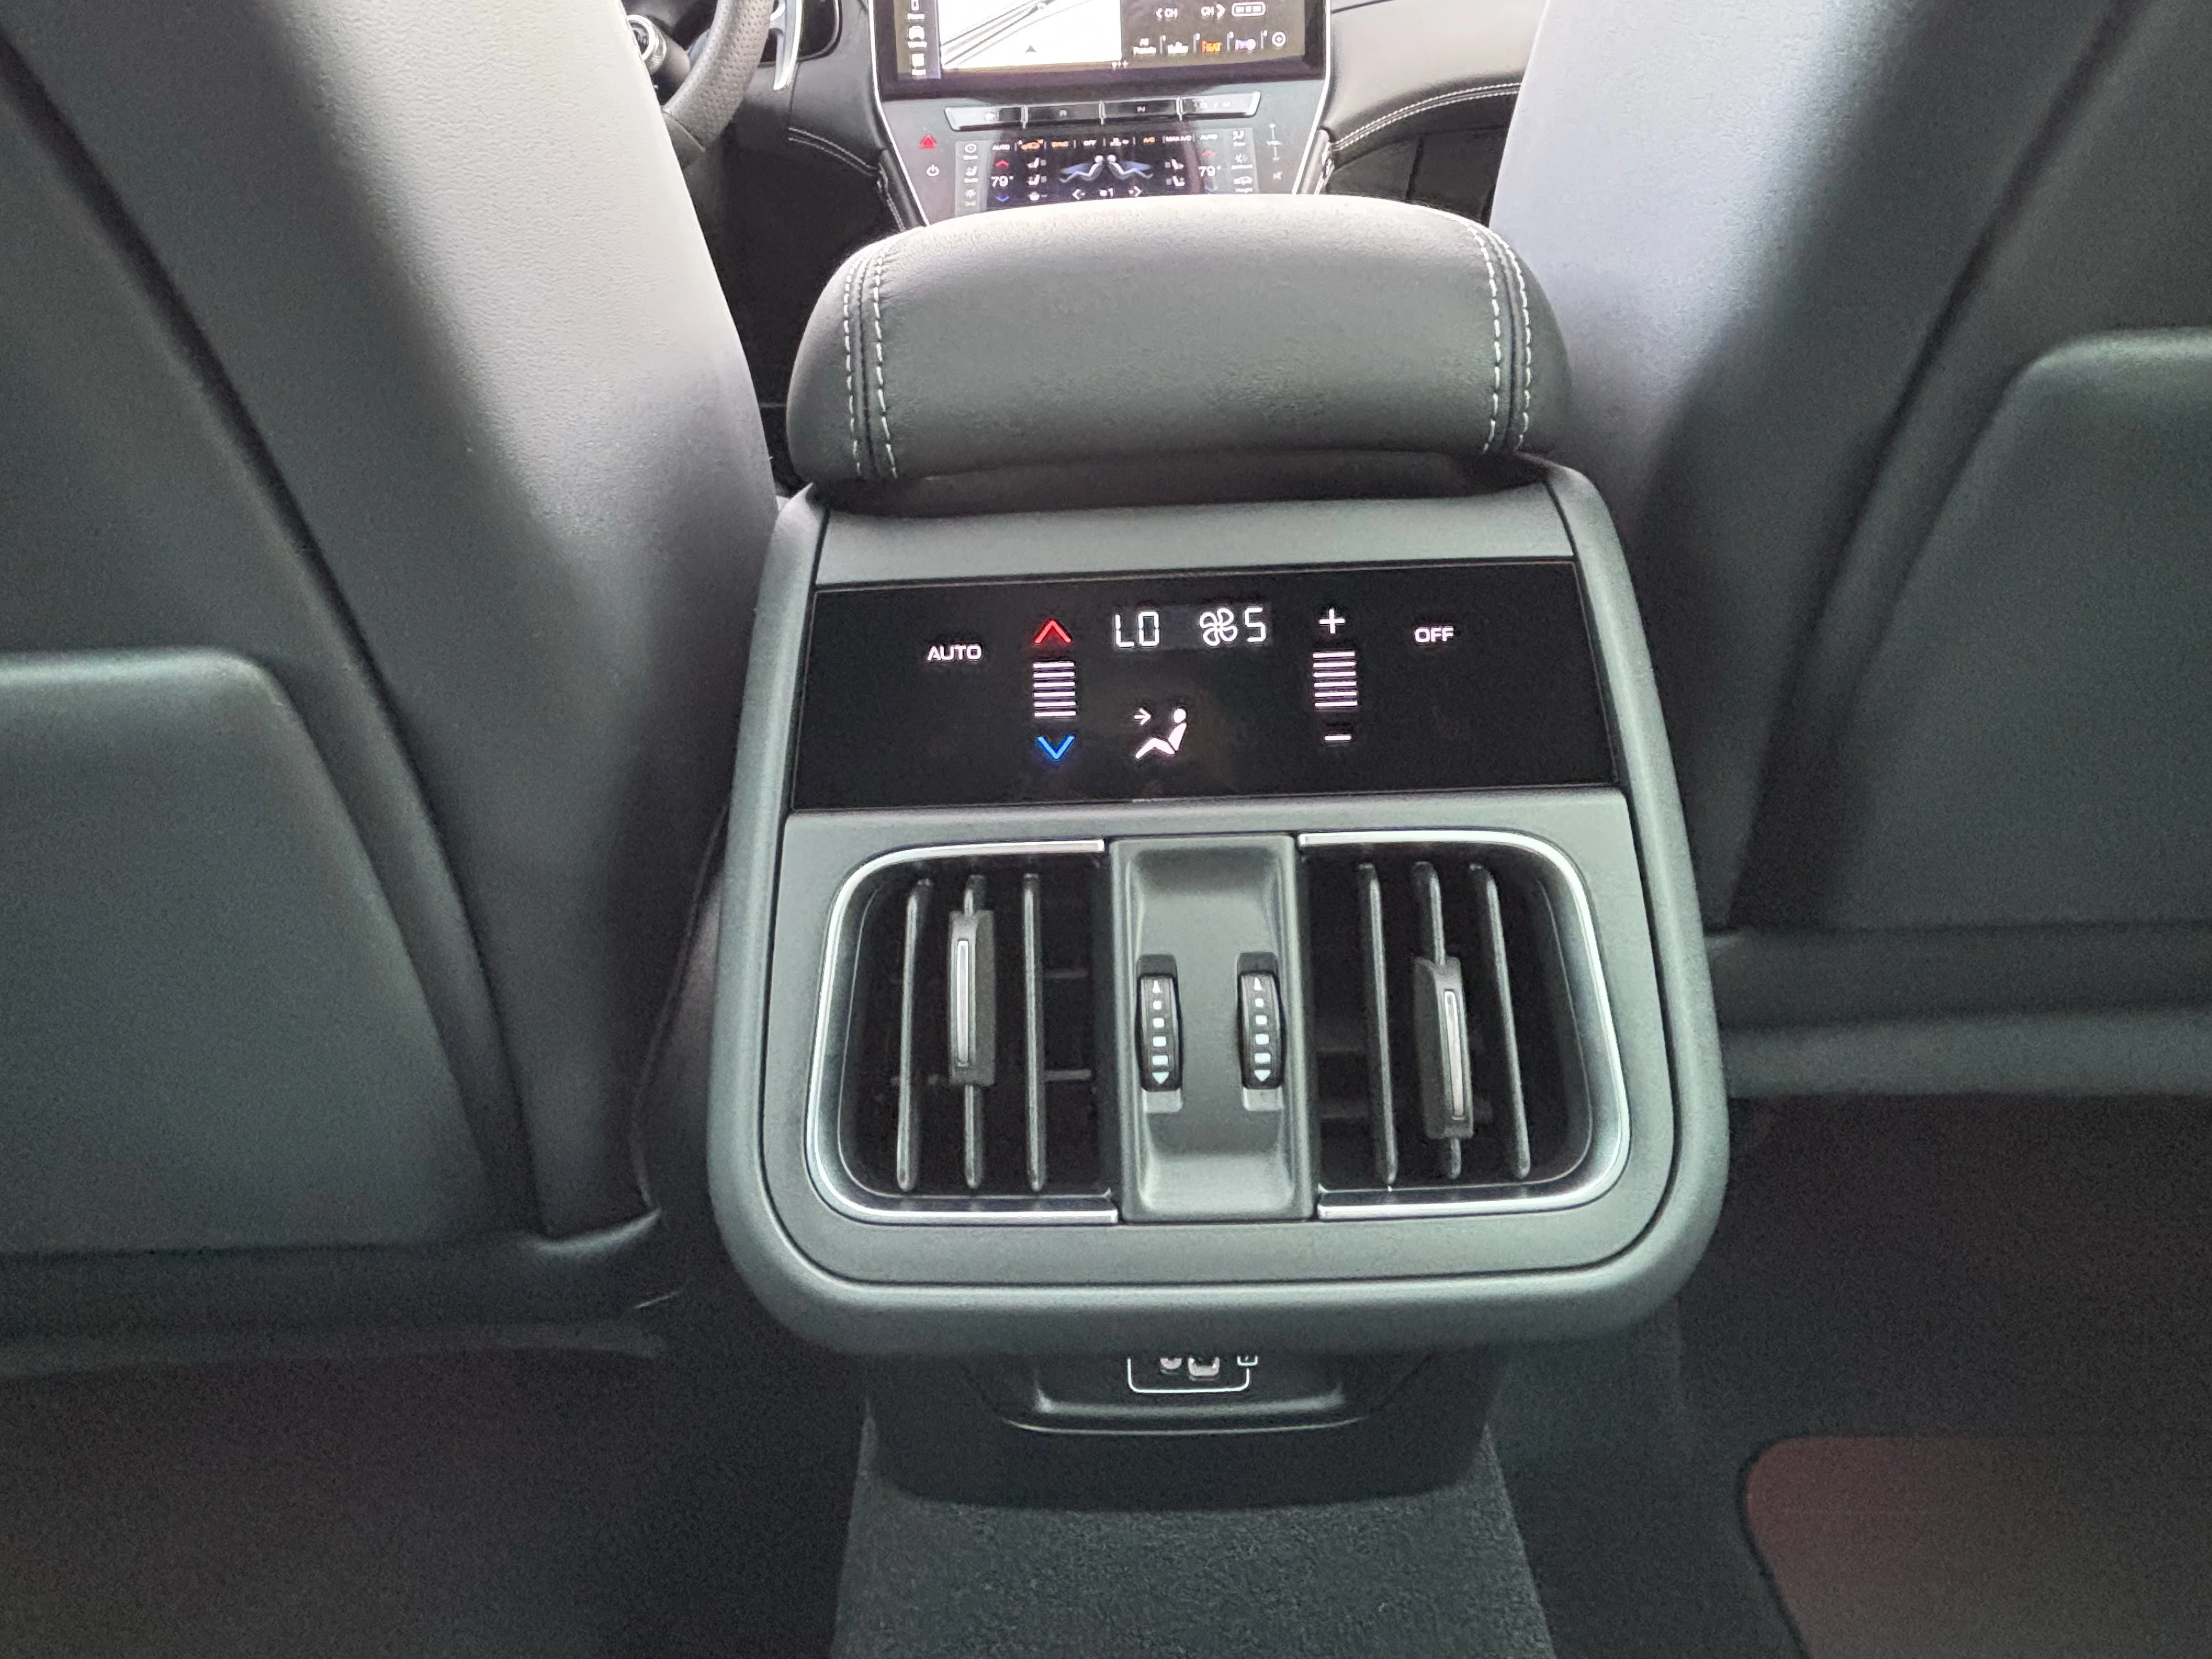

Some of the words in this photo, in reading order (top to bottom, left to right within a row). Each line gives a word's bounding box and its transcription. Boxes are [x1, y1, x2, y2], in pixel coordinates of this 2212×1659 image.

[1114, 610, 1160, 649] LO
[1242, 605, 1267, 644] 5
[1413, 625, 1454, 644] OFF
[926, 643, 983, 662] AUTO
